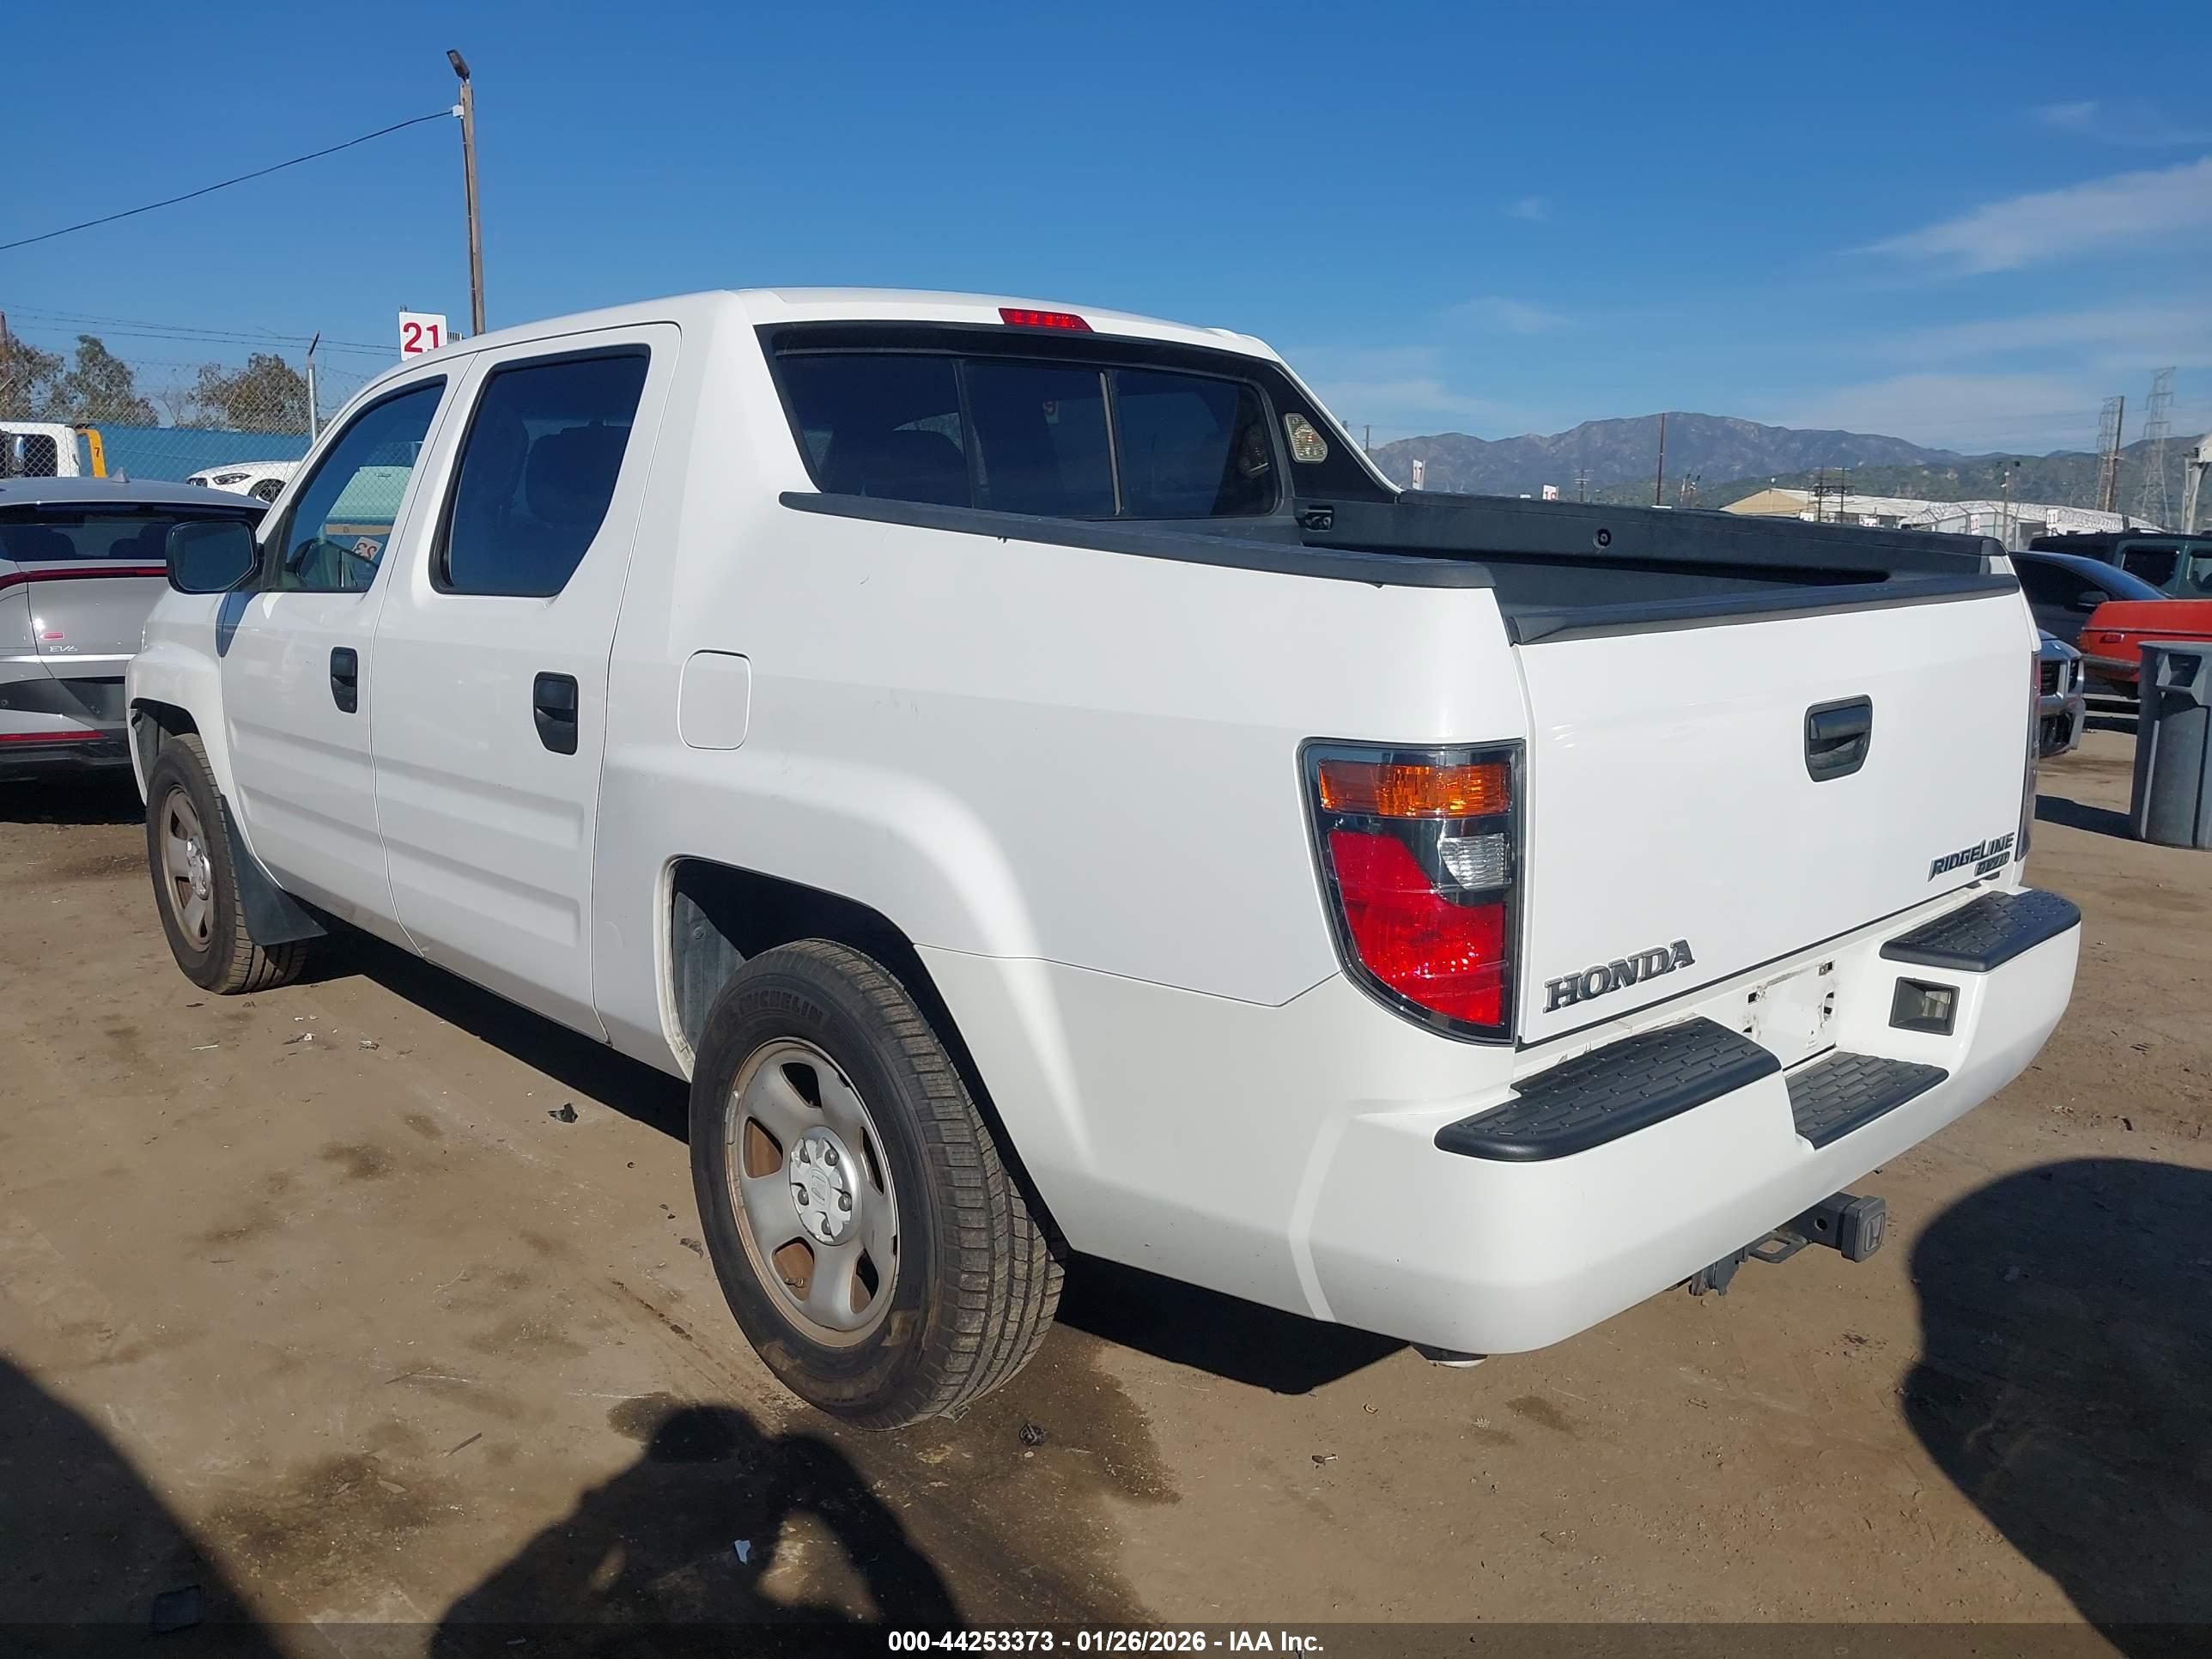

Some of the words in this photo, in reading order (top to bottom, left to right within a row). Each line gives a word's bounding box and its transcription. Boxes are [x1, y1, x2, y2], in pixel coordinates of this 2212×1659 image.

[404, 322, 439, 353] 21
[94, 447, 100, 458] 7
[1927, 831, 2014, 883] RIDGELINE
[1542, 939, 1696, 1014] HONDA
[738, 988, 825, 1025] MICHELIN
